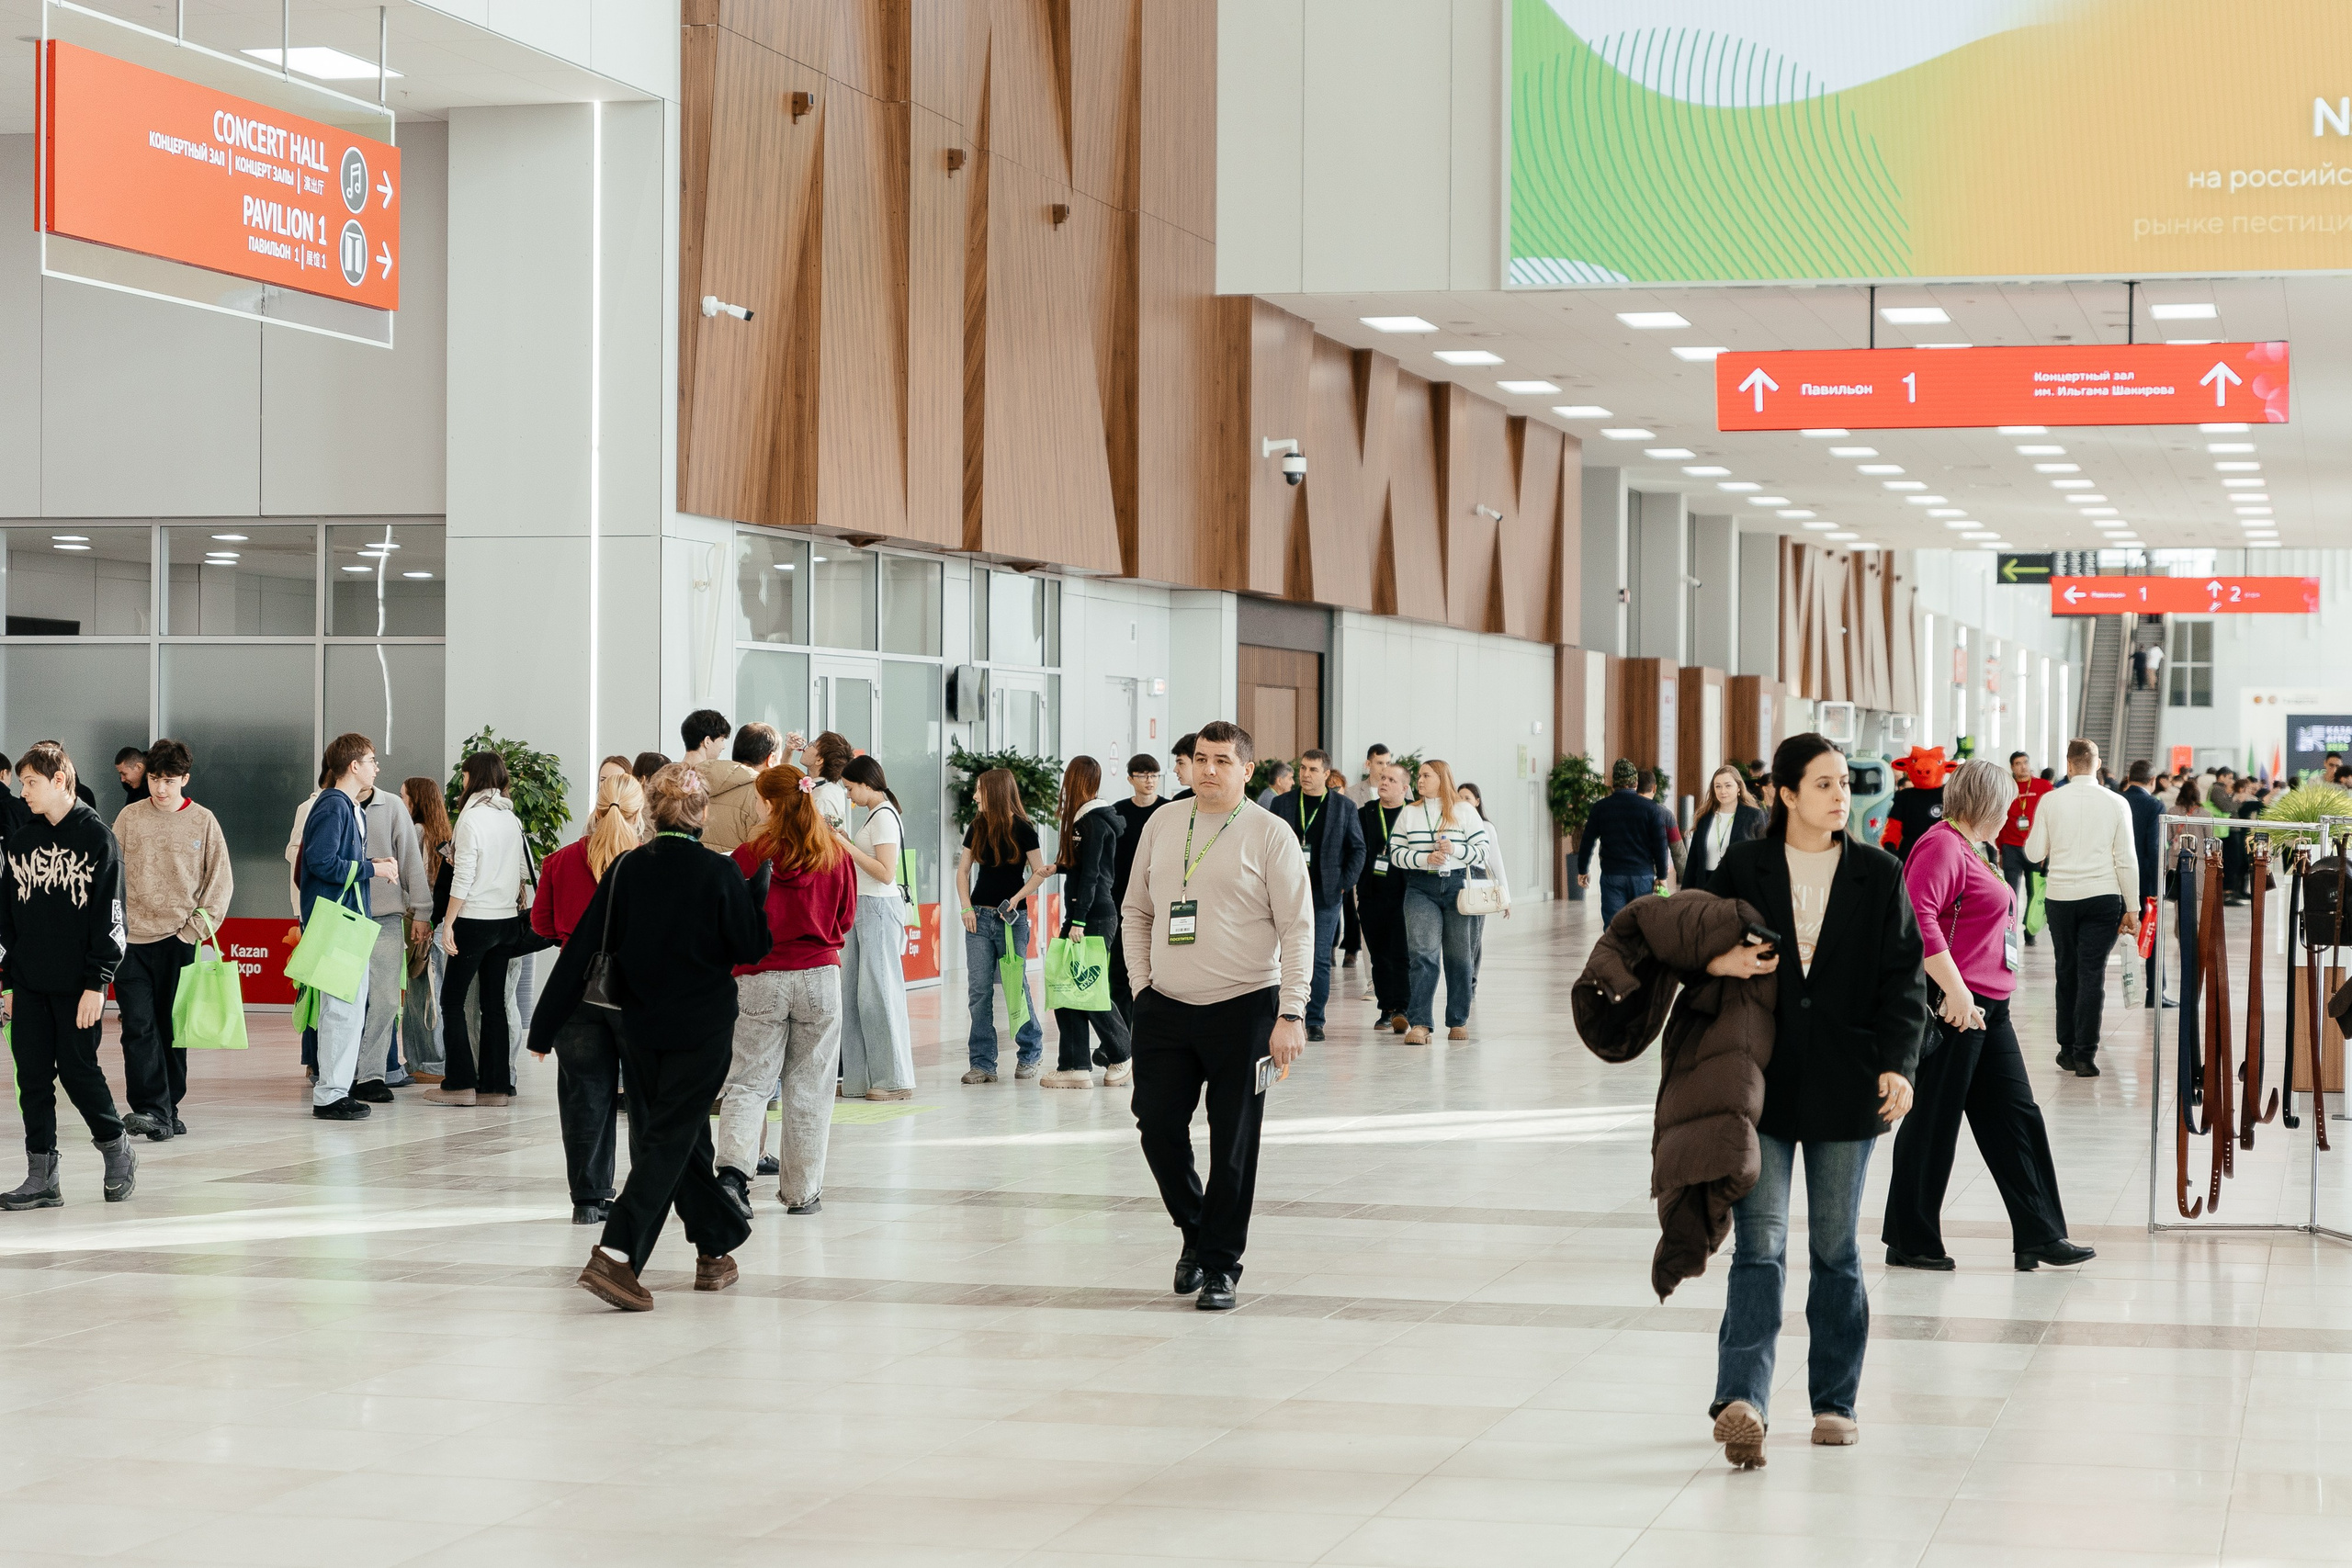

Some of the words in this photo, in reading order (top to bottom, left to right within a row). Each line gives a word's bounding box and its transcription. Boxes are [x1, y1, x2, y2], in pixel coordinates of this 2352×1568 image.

[2313, 96, 2352, 137] N
[149, 130, 208, 162] КОНЦЕРТНЫЙ
[209, 147, 225, 166] ЗАЛ
[213, 109, 288, 159] CONCERT
[289, 132, 329, 173] HALL
[234, 155, 272, 179] КОНЦЕРТ
[272, 165, 294, 186] ЗАЛЫ
[2188, 170, 2222, 188] на
[2230, 161, 2352, 194] российс
[243, 194, 314, 243] PAVILION
[318, 215, 327, 245] 1
[2133, 216, 2224, 242] рынке
[248, 235, 291, 260] ПАВИЛЬОН
[294, 246, 300, 263] 1
[321, 253, 327, 269] 1
[1801, 383, 1872, 396] Павильон
[1902, 372, 1916, 403] 1
[2033, 370, 2110, 383] Концертный
[2113, 372, 2135, 381] зал
[2034, 387, 2055, 397] им.
[2057, 386, 2109, 397] Ильгама
[2111, 384, 2176, 398] Шакирова
[2139, 586, 2148, 602] 1
[2230, 585, 2242, 603] 2
[231, 943, 268, 958] Kazan
[231, 960, 262, 976] xpo
